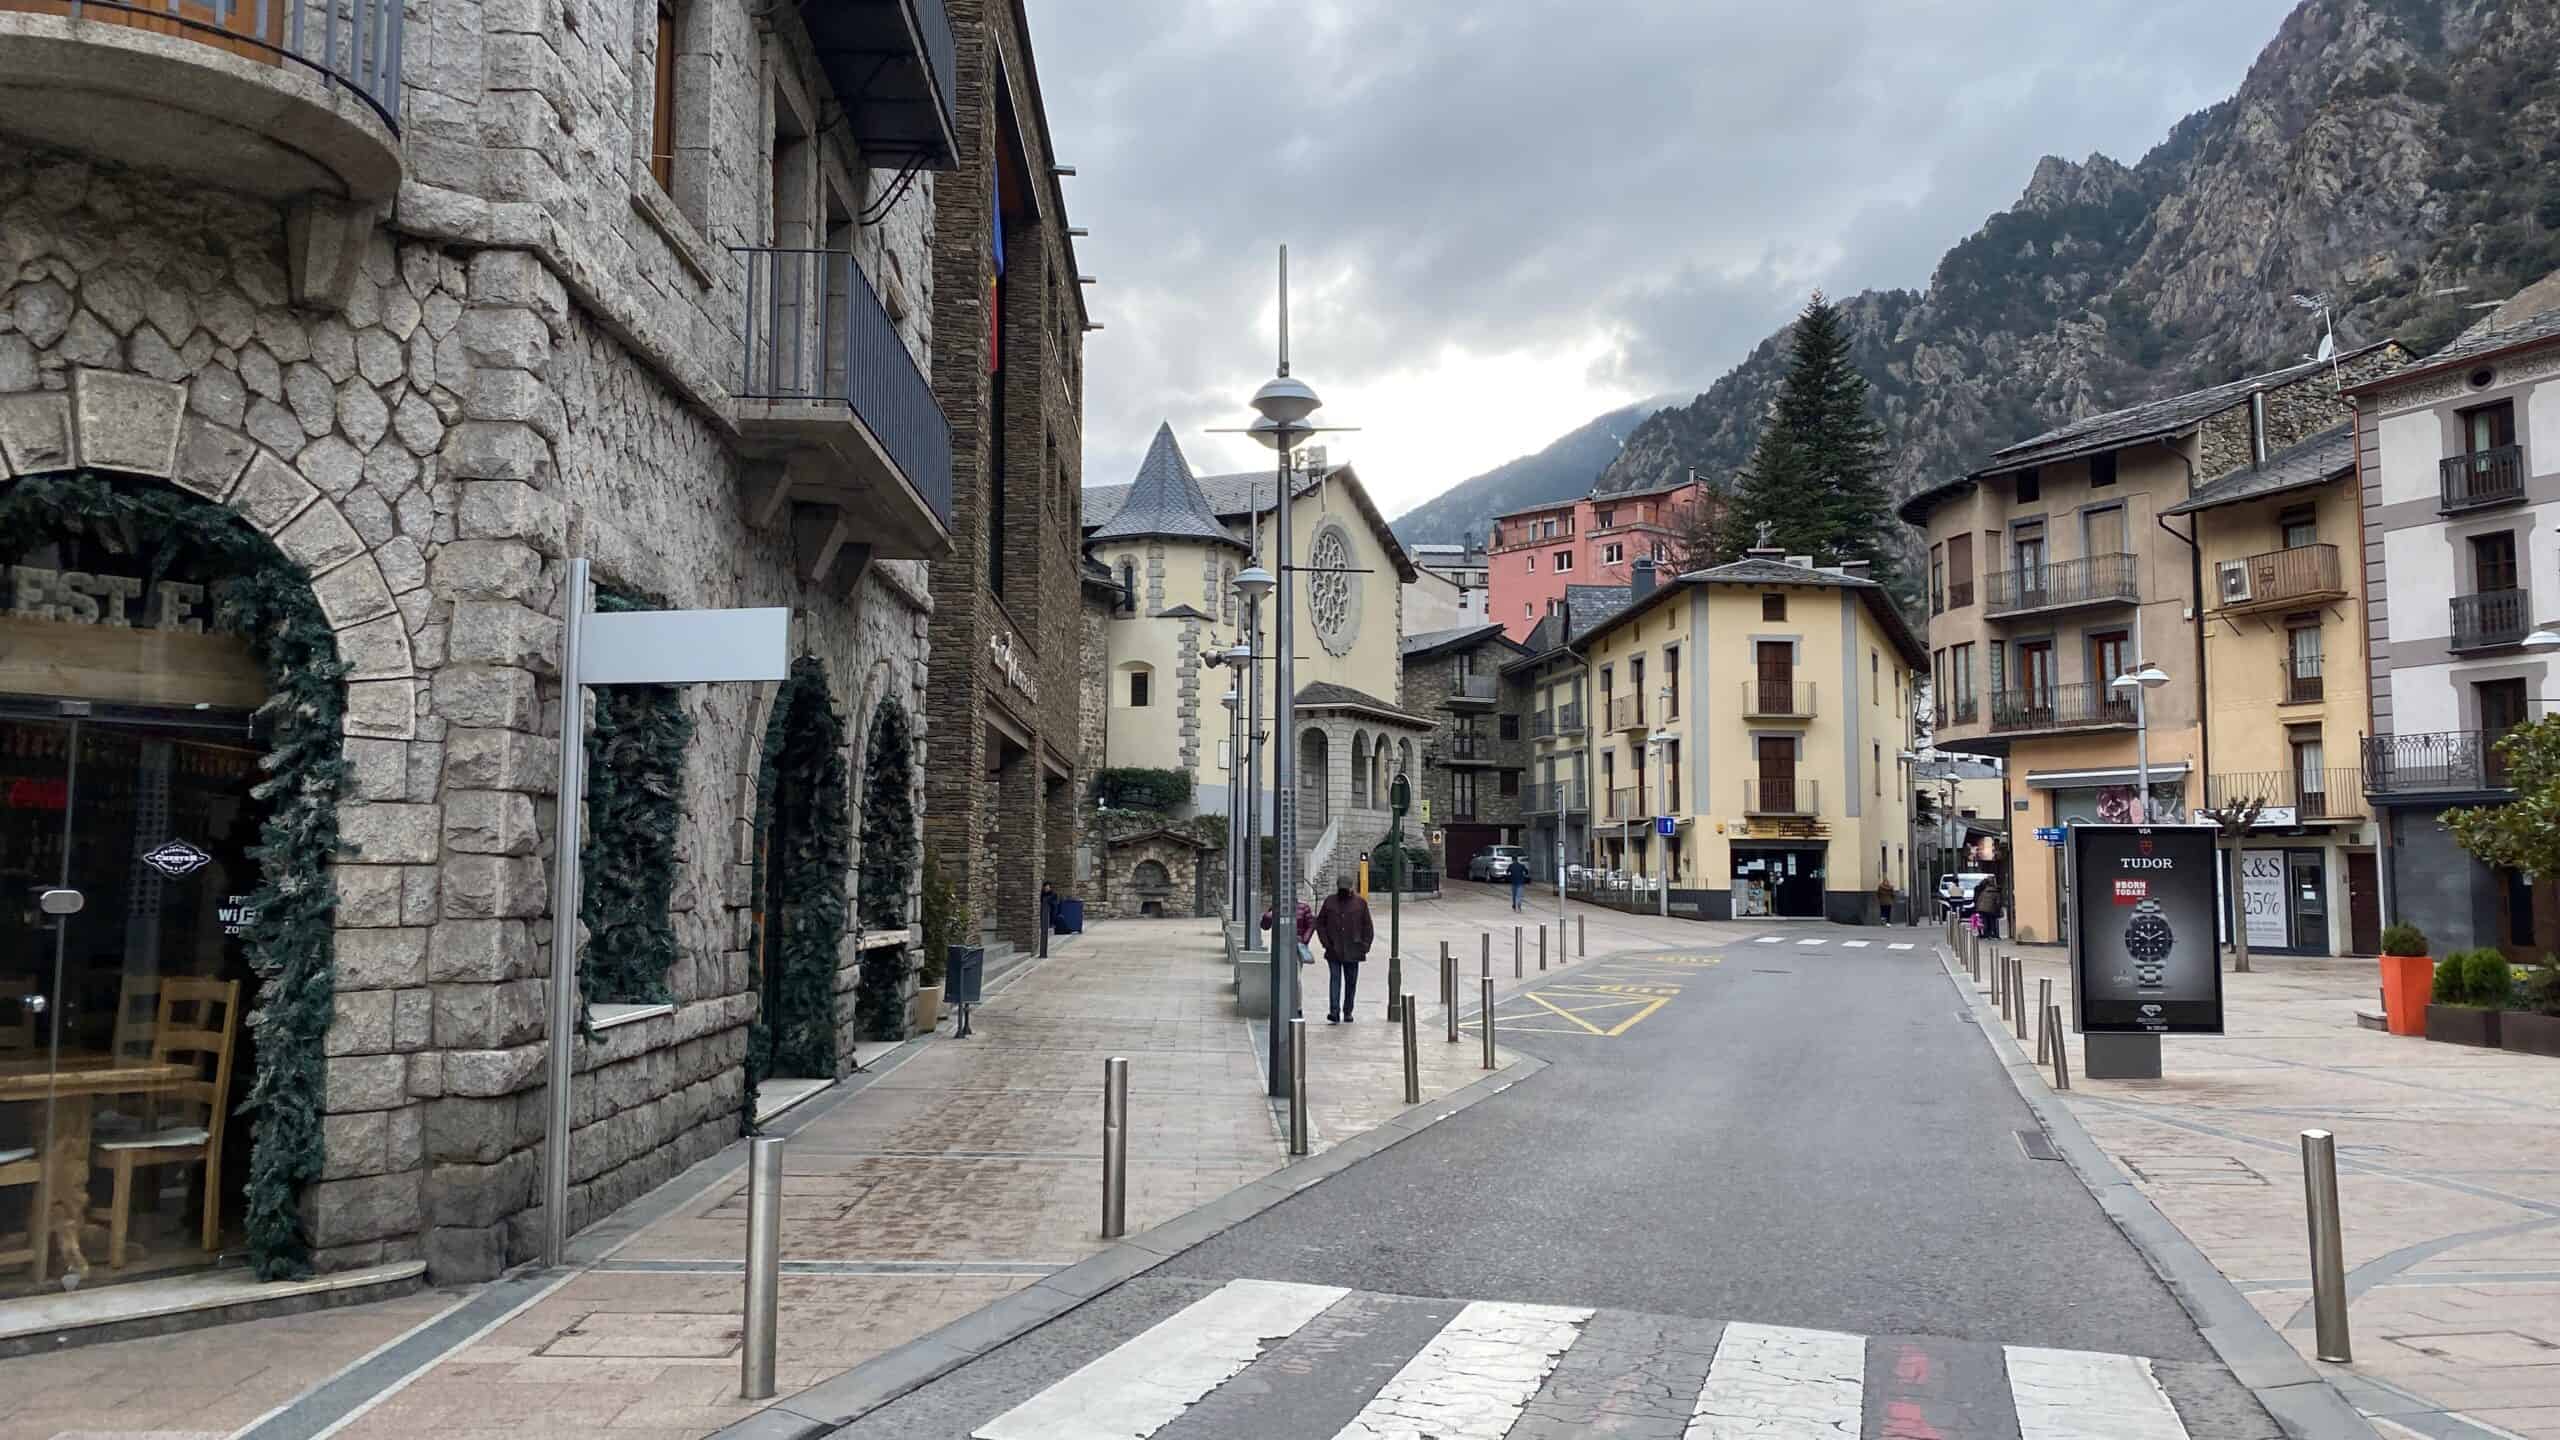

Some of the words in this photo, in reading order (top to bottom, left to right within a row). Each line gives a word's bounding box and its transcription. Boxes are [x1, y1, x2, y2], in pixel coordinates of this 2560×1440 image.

[0, 564, 232, 634] ESTE
[2120, 858, 2174, 869] TUDOR
[2244, 891, 2280, 915] 25%
